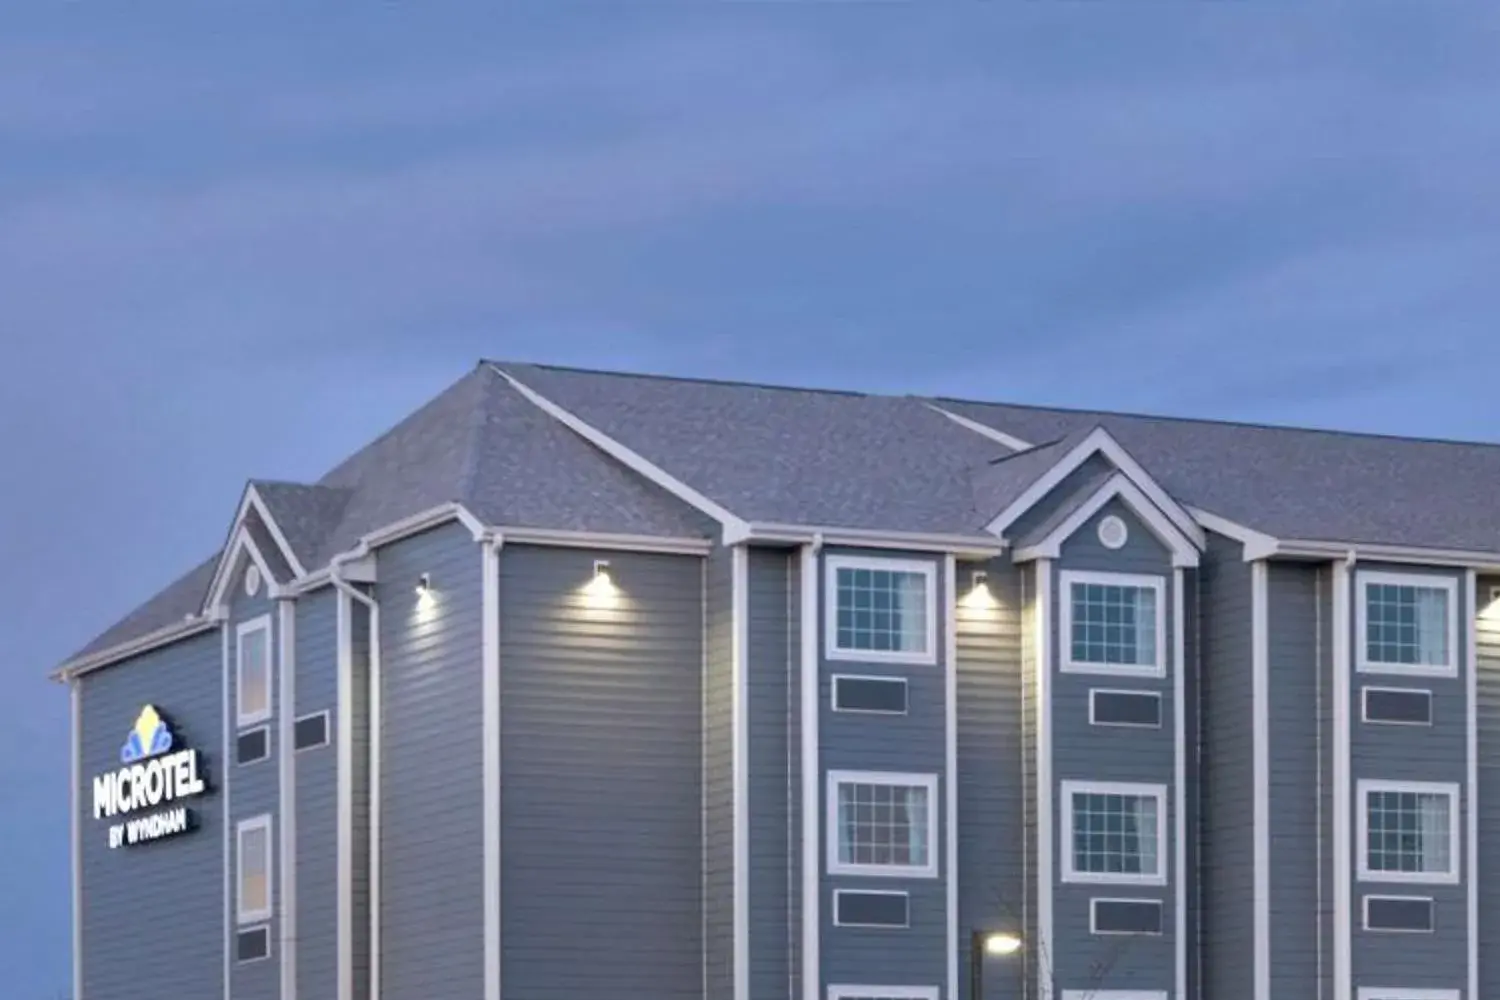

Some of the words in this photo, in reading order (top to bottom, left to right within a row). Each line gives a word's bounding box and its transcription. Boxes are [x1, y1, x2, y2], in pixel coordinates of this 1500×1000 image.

[93, 749, 204, 819] MICROTEL
[109, 824, 124, 848] BY
[127, 808, 186, 844] WYNDHAM
